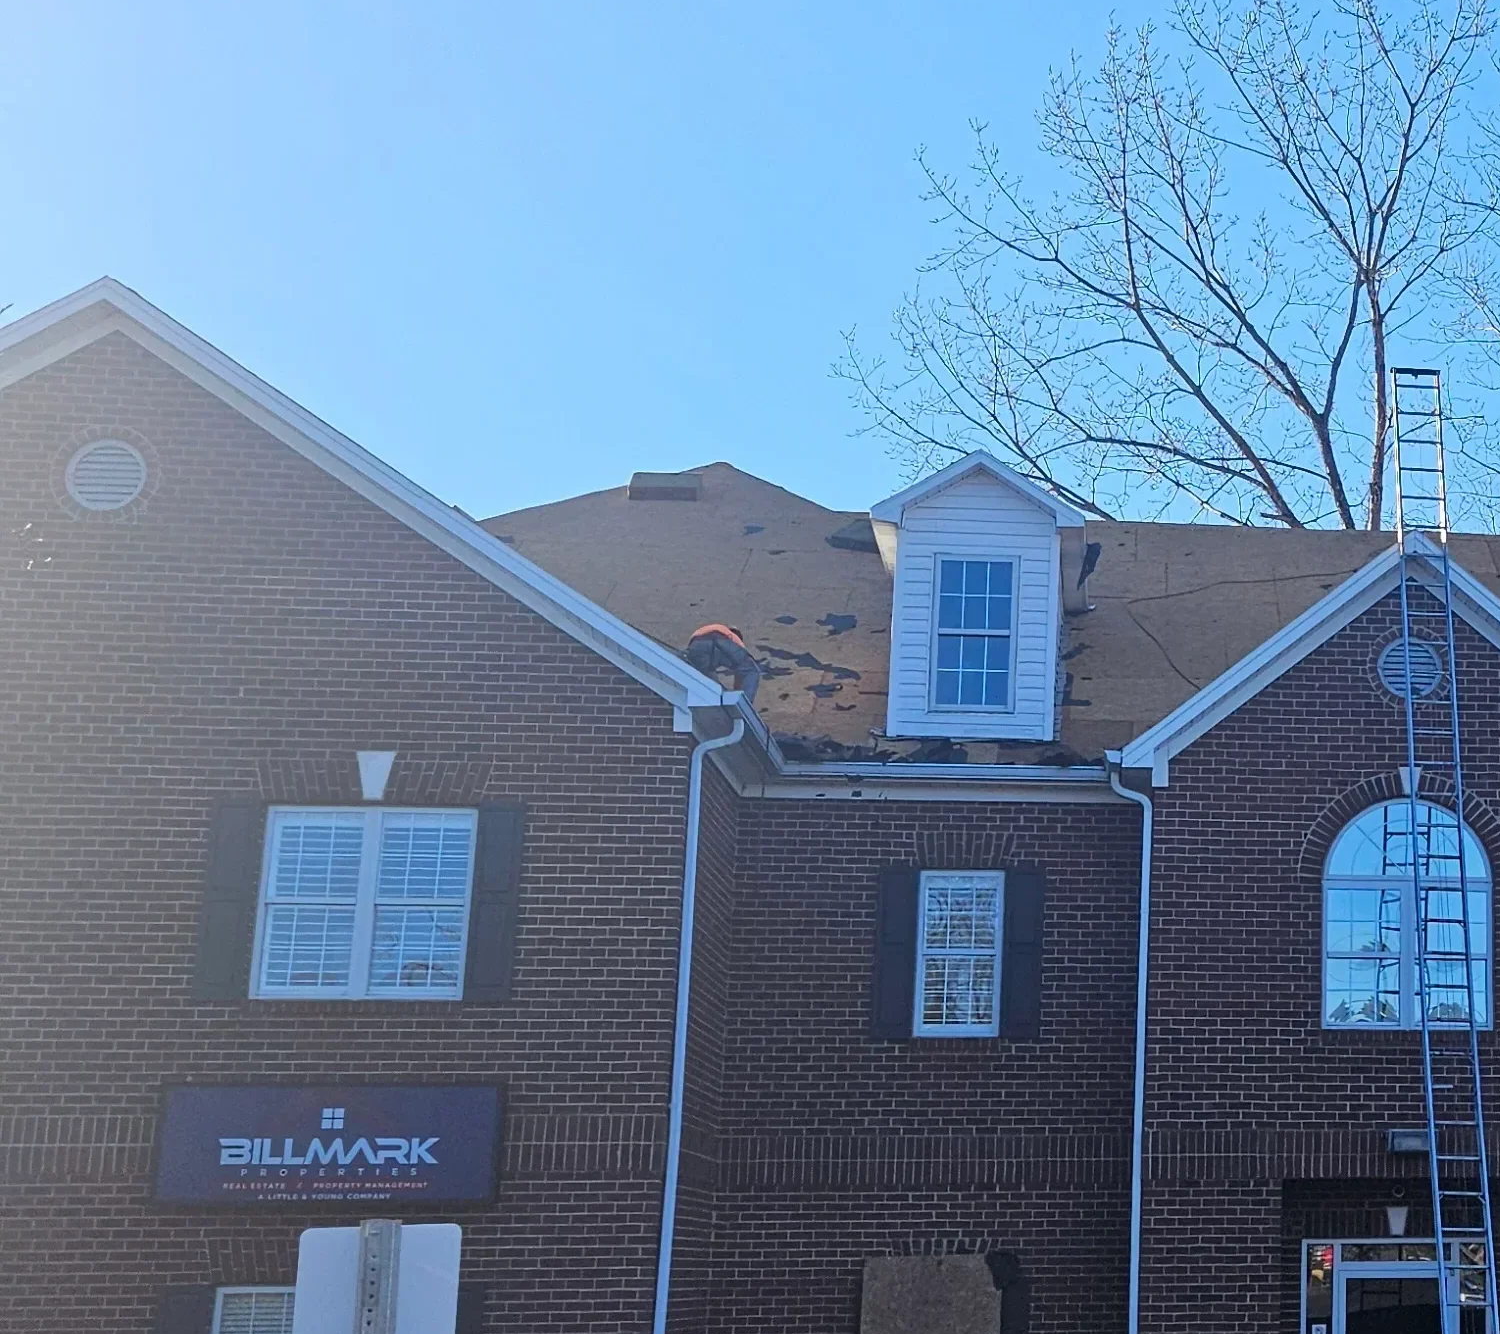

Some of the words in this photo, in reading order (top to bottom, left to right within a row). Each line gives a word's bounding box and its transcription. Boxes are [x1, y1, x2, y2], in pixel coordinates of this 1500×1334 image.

[218, 1137, 440, 1165] BILLMARK
[240, 1168, 418, 1176] PROPERTIES
[222, 1182, 247, 1190] REAL
[250, 1182, 286, 1190] ESTATE
[364, 1181, 428, 1189] MANAGEMENT
